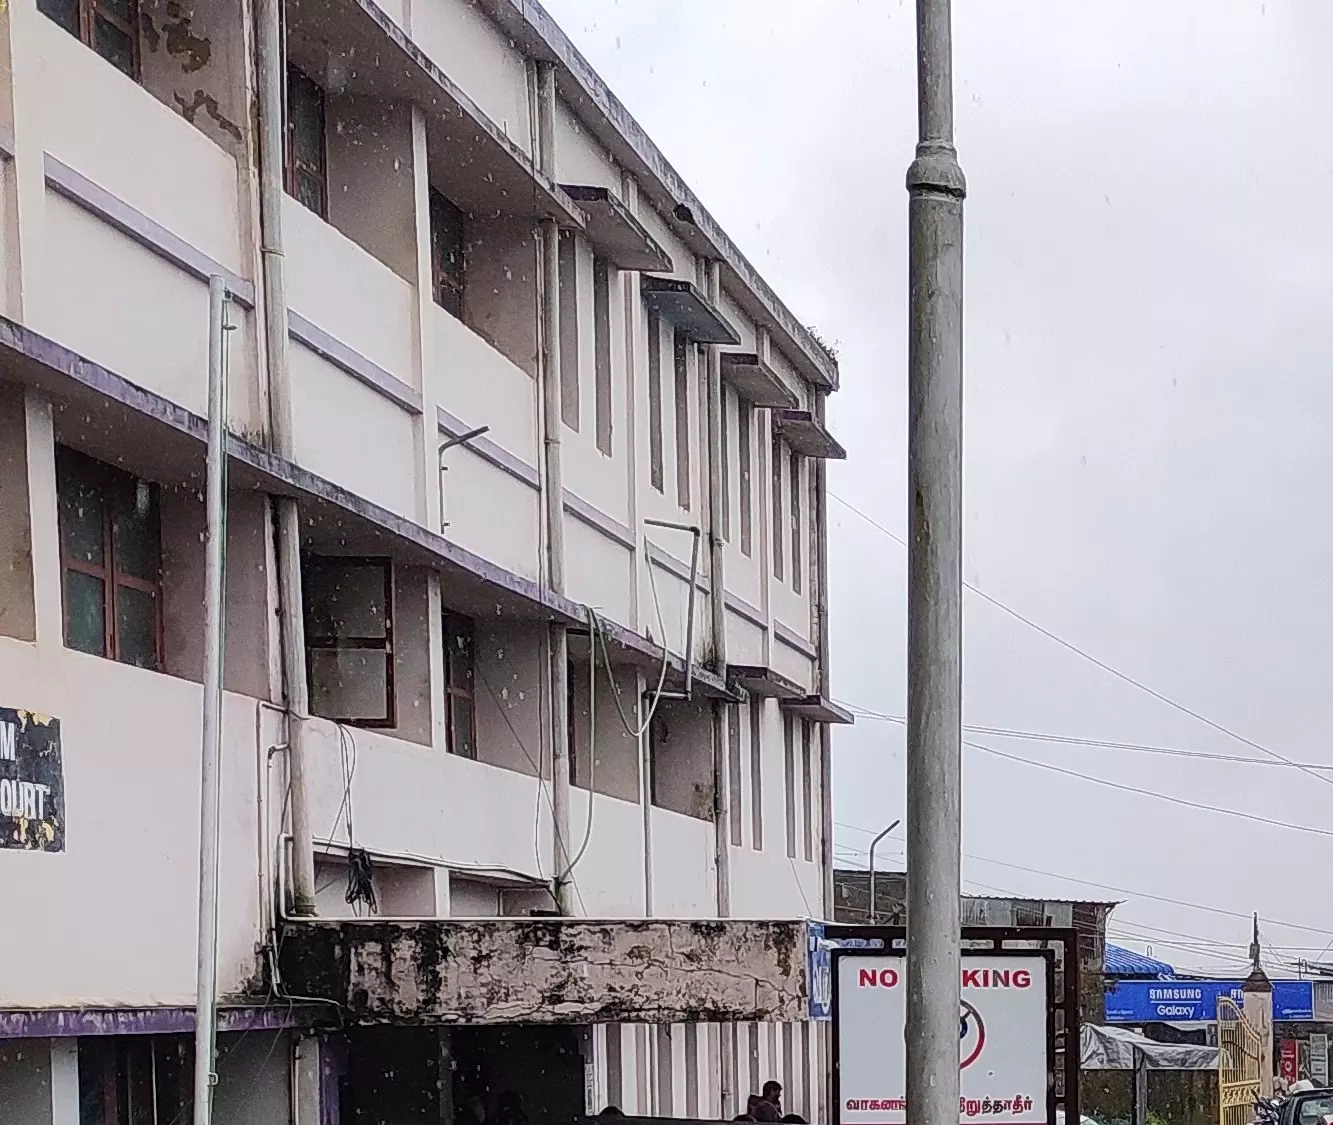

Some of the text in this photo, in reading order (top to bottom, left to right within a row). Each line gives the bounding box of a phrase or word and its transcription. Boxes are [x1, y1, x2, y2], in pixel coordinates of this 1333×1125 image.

[0, 778, 50, 820] OURT
[859, 969, 1031, 988] NO KING
[1157, 1005, 1195, 1018] Galaxy
